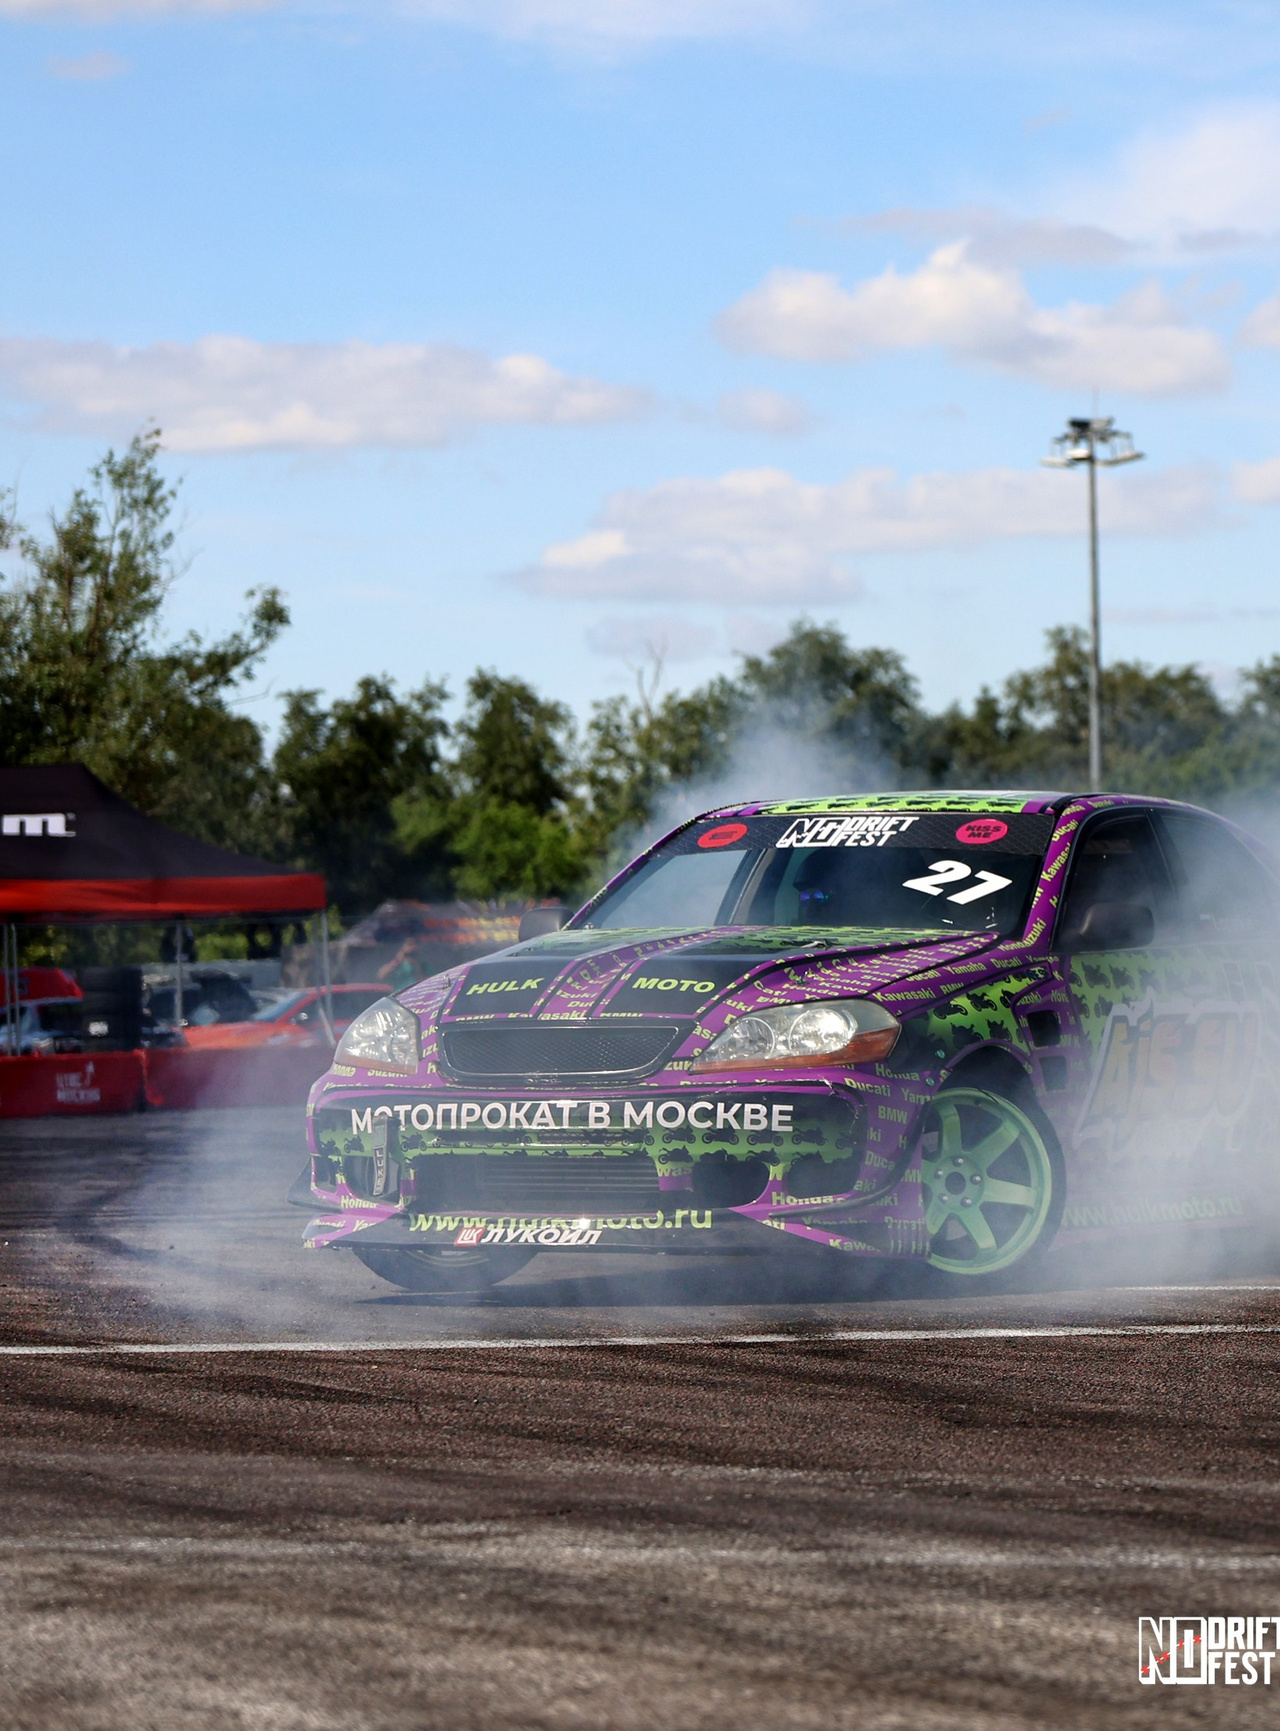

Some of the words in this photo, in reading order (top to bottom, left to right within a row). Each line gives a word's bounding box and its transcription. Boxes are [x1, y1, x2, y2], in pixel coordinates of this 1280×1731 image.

[848, 816, 920, 832] DRIFT
[965, 824, 1002, 833] KISS
[832, 831, 897, 847] FEST
[902, 860, 1013, 905] 27
[943, 962, 987, 976] Yamaha
[990, 956, 1022, 969] Ducati
[466, 977, 545, 996] HULK
[632, 977, 715, 993] MOTO
[872, 988, 936, 1002] Kawasaki
[844, 1077, 891, 1097] Ducati
[588, 1102, 610, 1128] В
[623, 1101, 794, 1132] МОСКВЕ
[878, 1105, 908, 1124] BMW
